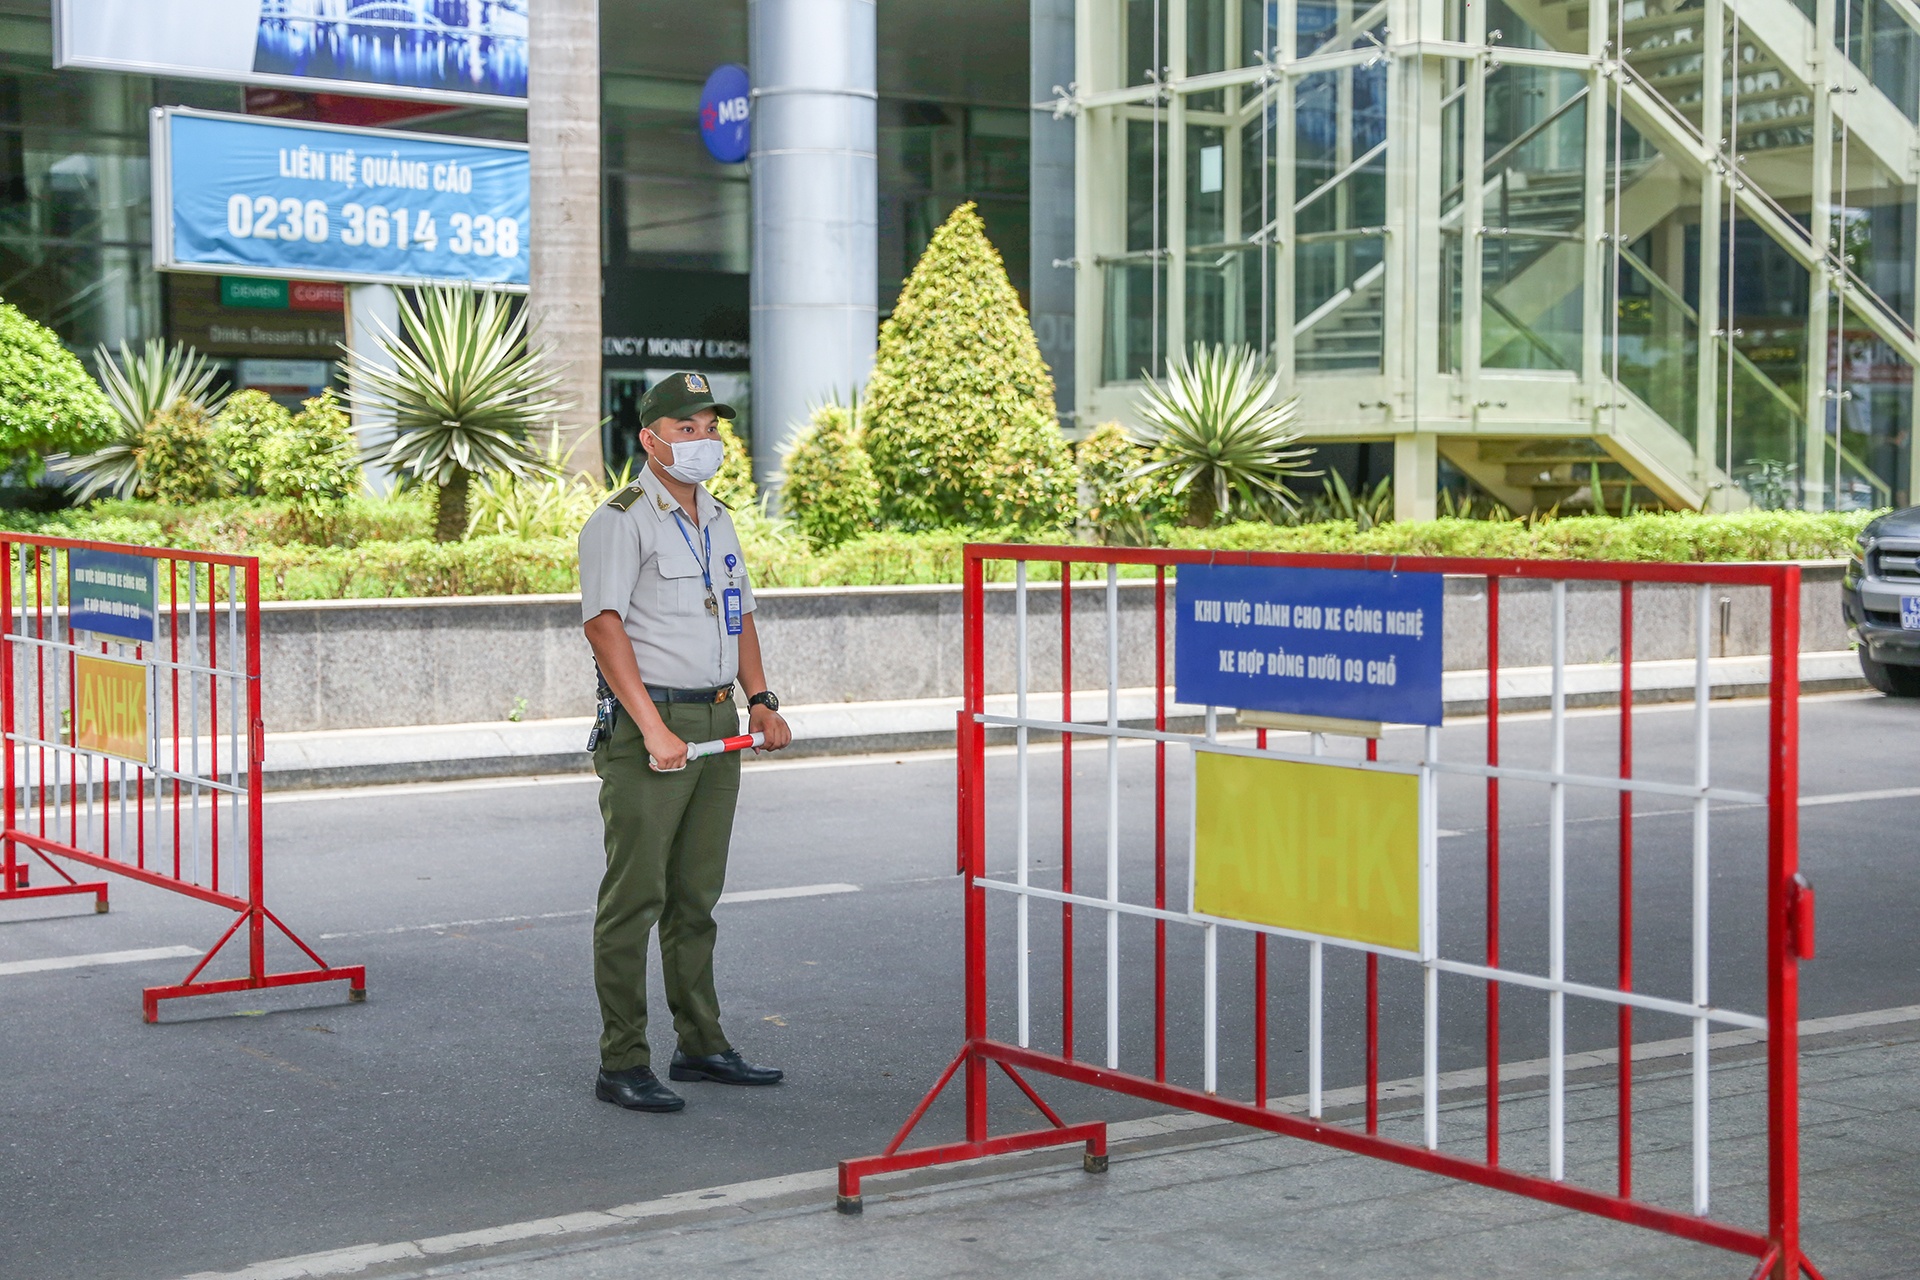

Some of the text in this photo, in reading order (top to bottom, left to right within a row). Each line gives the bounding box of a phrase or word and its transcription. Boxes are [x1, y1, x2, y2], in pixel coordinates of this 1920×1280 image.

[718, 97, 750, 125] MB
[279, 144, 473, 195] LIÊN HỆ QUẢNG CÁO
[226, 193, 520, 259] 0236 3614 338
[647, 336, 704, 358] MONEY
[1194, 598, 1424, 641] KHU VỰC DÀNH CHO XE CÔNG NGHỆ
[1219, 647, 1397, 686] XE HỢP ĐỒNG DƯỚI 09 CHỖ
[81, 672, 144, 746] ANHK
[1205, 784, 1406, 918] ANHK
